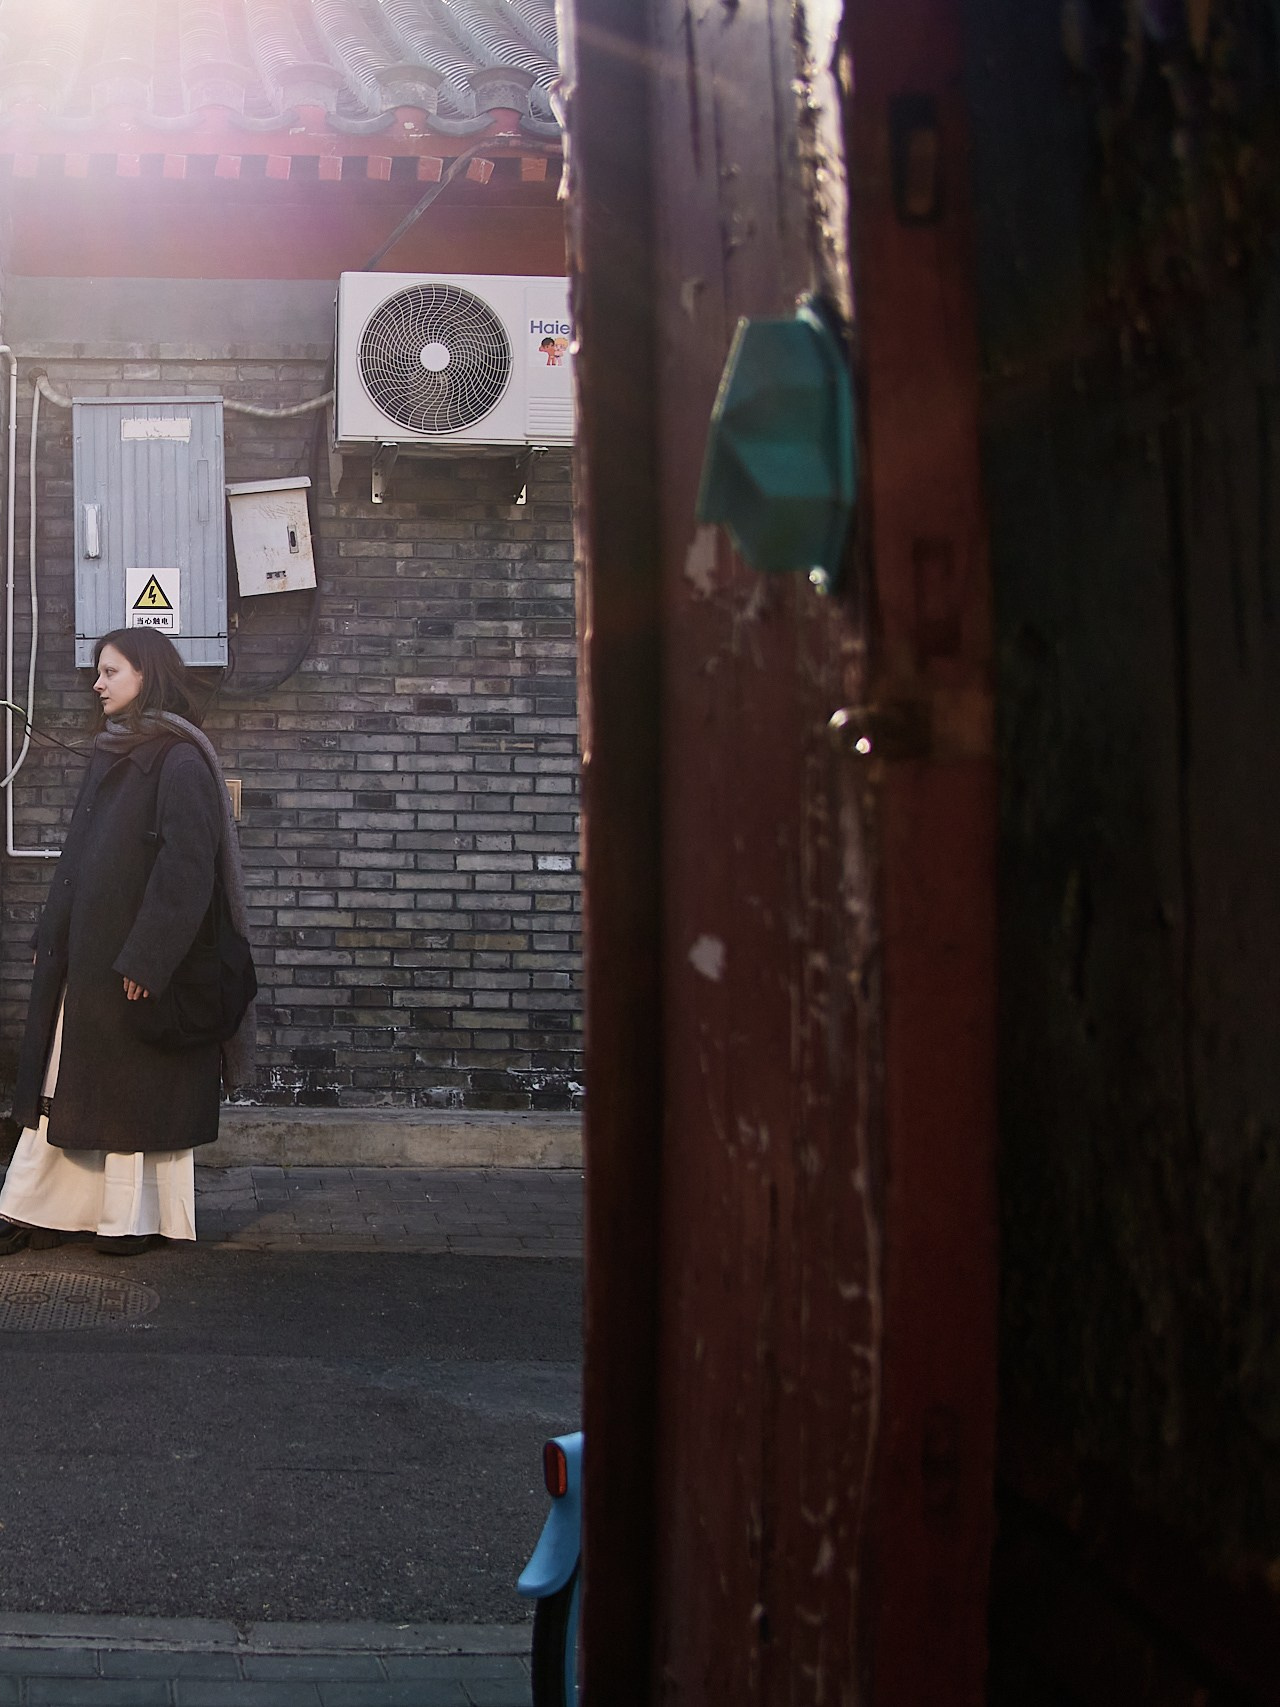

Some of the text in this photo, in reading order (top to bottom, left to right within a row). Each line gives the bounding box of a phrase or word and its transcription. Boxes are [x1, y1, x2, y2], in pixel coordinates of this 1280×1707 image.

[530, 320, 571, 335] Haie
[136, 617, 169, 625] 当心触电
